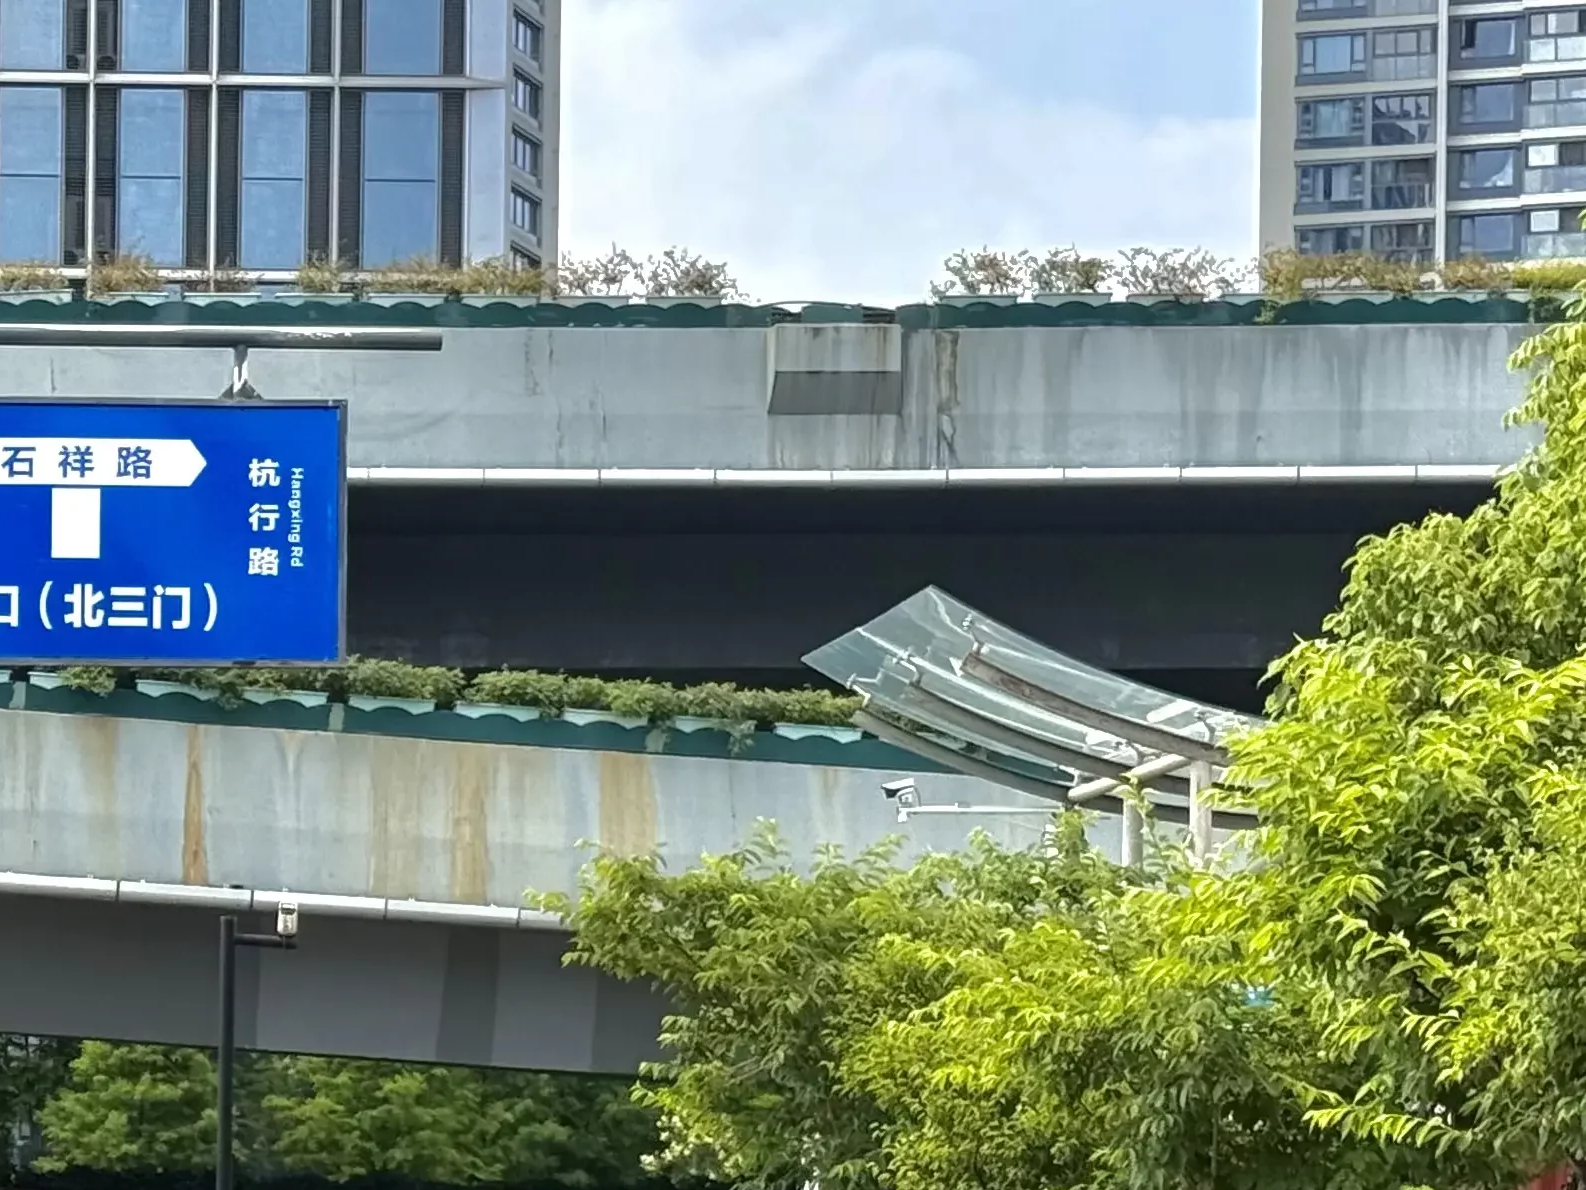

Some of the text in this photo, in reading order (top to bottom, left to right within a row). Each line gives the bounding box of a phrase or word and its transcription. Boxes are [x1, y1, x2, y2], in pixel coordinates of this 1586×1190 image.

[0, 444, 154, 480] 石祥路
[246, 458, 282, 577] 杭行路
[287, 467, 305, 568] Hangxing Rd
